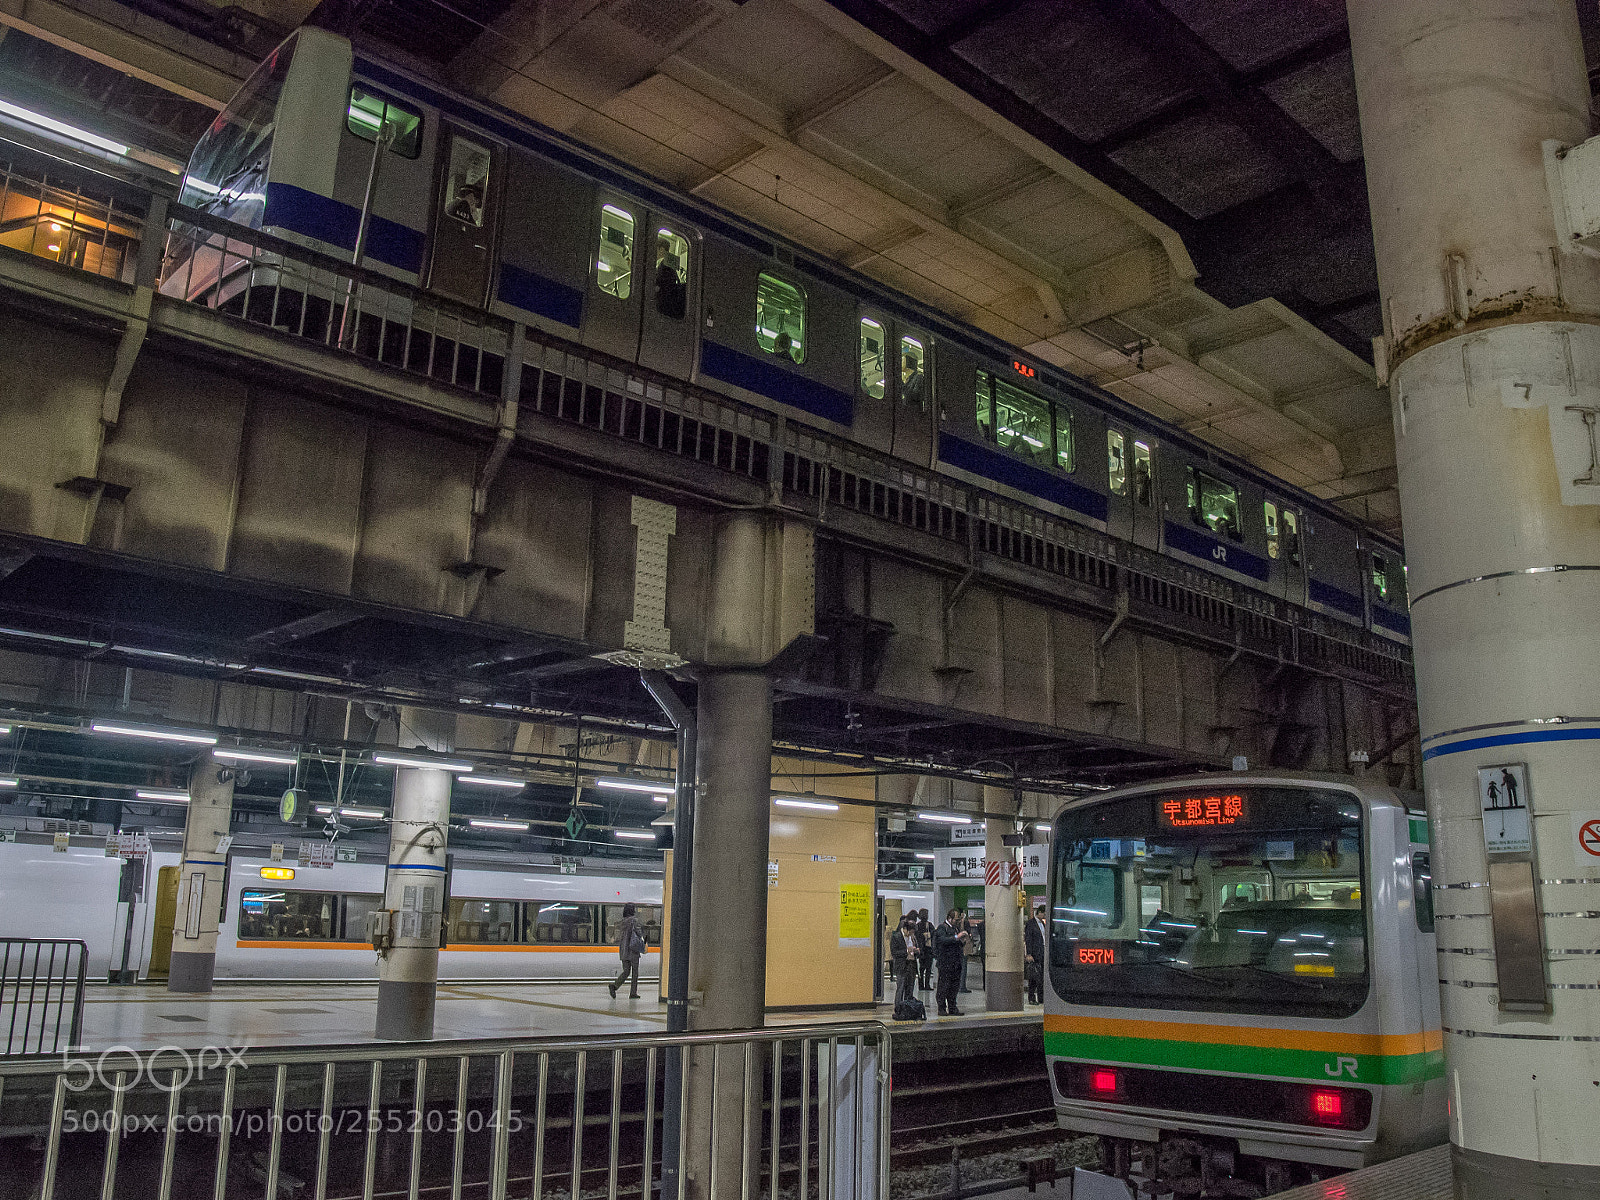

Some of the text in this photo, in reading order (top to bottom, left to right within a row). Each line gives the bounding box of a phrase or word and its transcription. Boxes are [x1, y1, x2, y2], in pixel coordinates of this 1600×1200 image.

[1212, 545, 1227, 562] JR
[1163, 795, 1243, 820] 宇都宮線
[1172, 816, 1235, 826] Utsunomiya Line
[1079, 948, 1114, 964] 557M
[1325, 1056, 1359, 1078] JR
